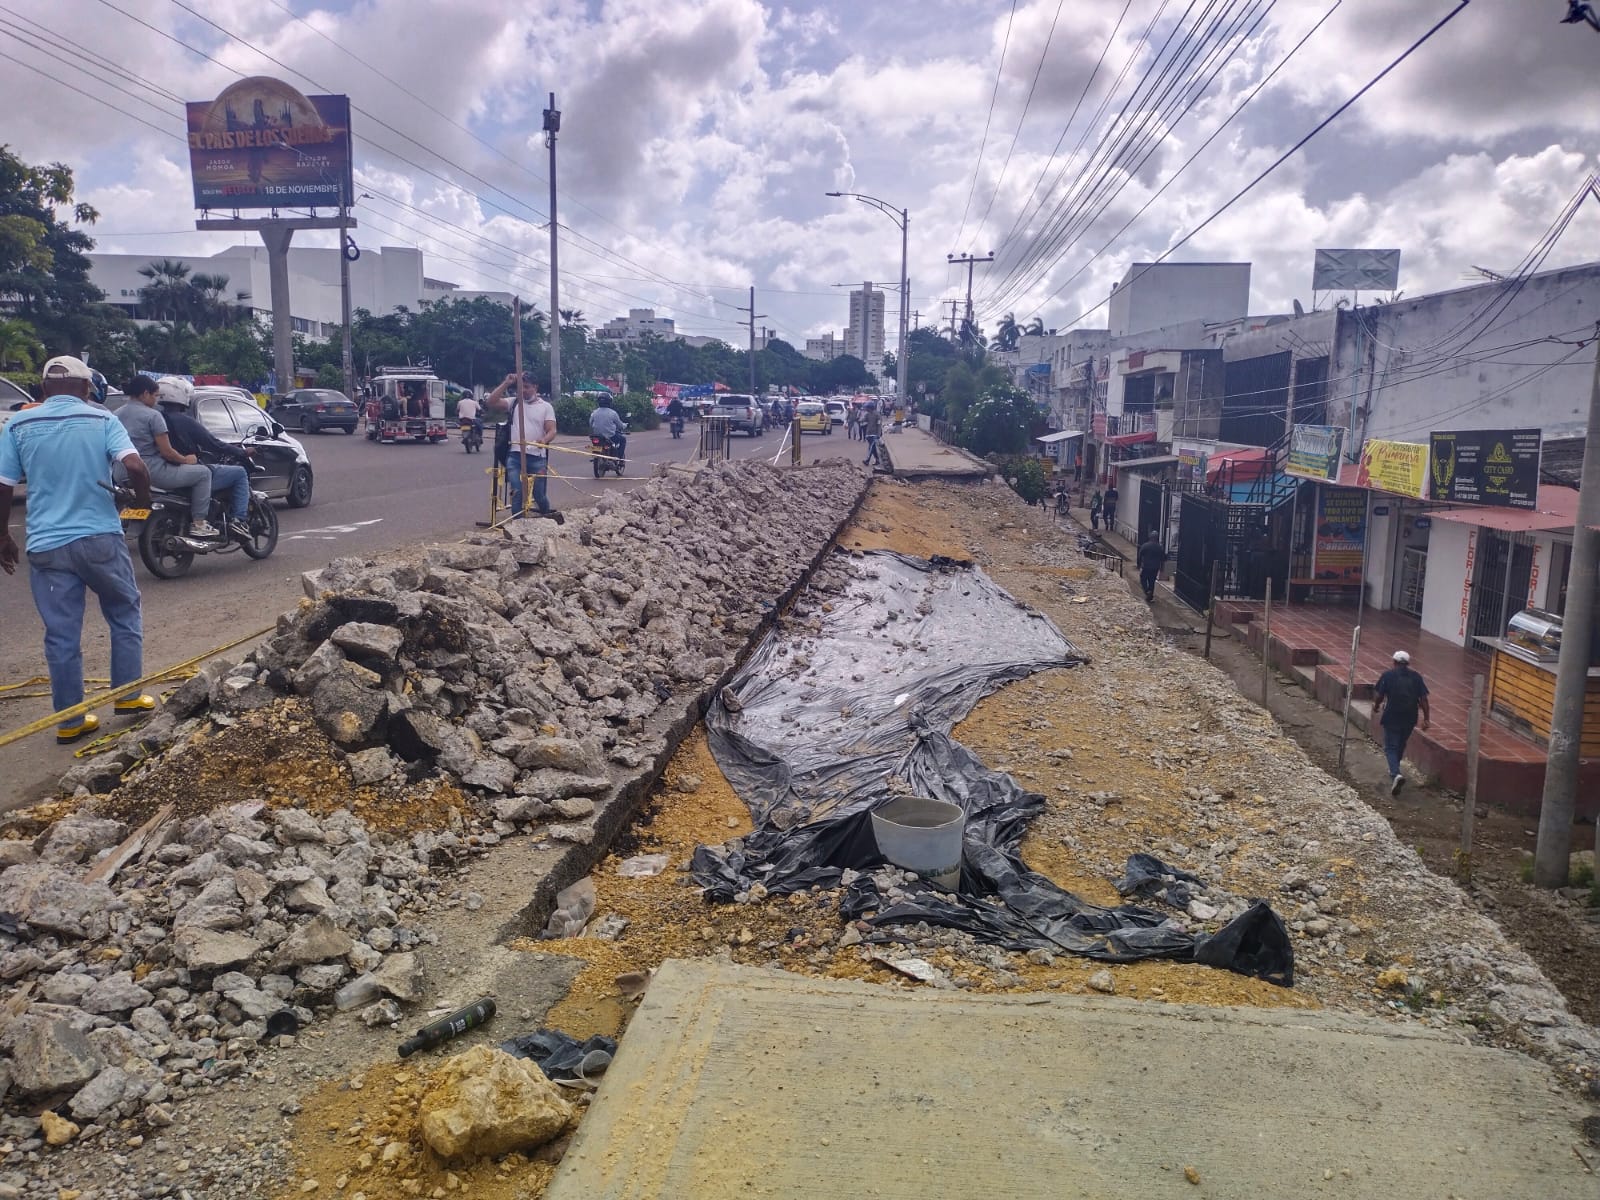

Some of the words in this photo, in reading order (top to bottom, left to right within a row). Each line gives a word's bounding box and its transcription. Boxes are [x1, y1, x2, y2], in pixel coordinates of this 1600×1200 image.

[235, 129, 255, 148] DE
[265, 185, 274, 194] 18
[275, 185, 288, 194] DE
[288, 184, 338, 194] NOVIEMBRE
[1458, 530, 1477, 638] FLORISTERIA
[1526, 544, 1542, 611] FLORIS
